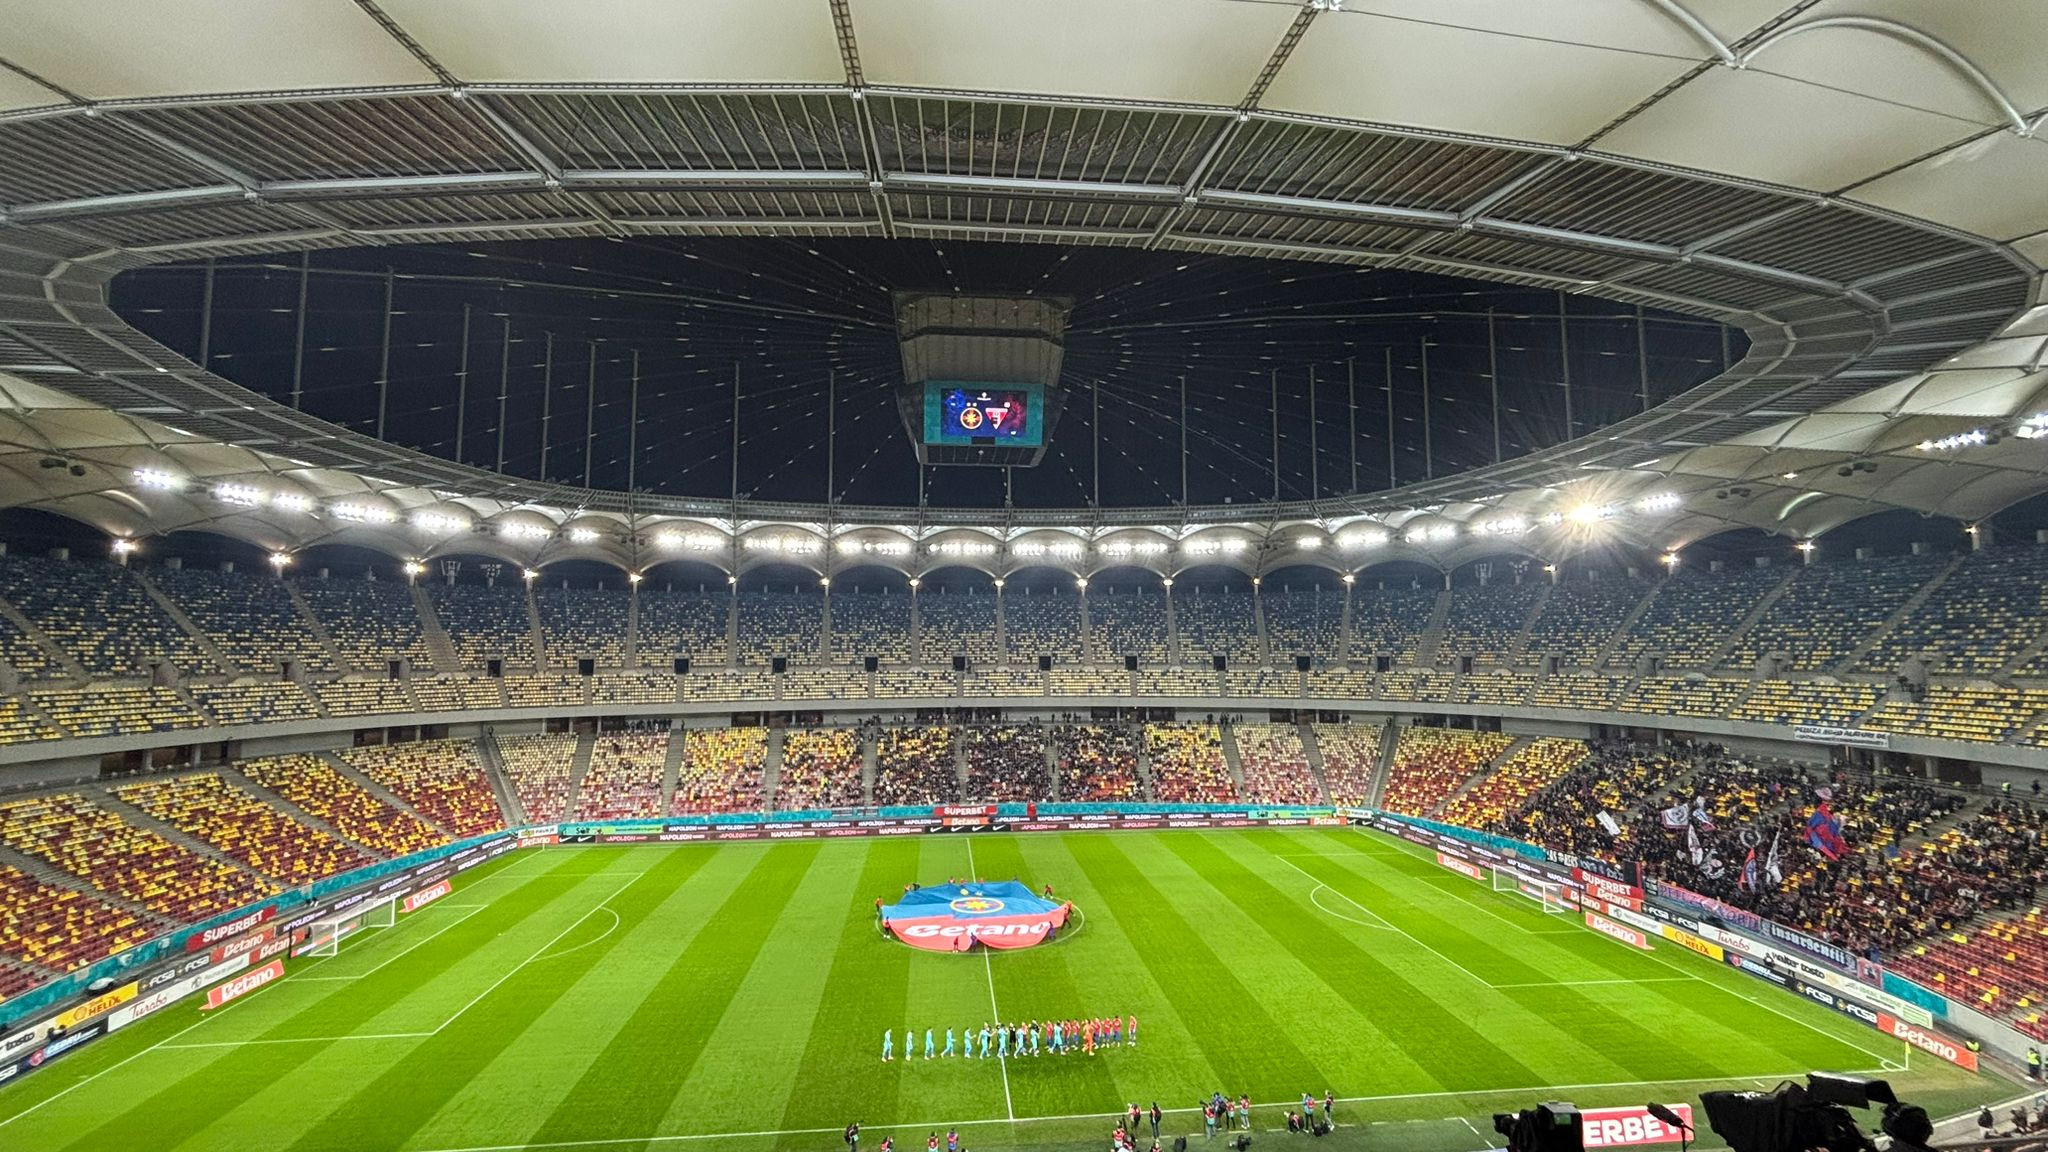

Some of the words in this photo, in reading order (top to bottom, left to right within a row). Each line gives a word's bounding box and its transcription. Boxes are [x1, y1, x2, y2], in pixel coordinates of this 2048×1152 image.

[944, 806, 987, 815] SUPERBET
[1582, 870, 1631, 896] SUPERBET
[1597, 887, 1631, 908] Betano
[202, 910, 264, 943] SUPERBET
[903, 920, 1051, 938] Betano
[1594, 914, 1637, 945] Betano
[223, 934, 264, 958] Betano
[1684, 939, 1709, 955] HELIX
[222, 967, 275, 1001] Betano
[88, 996, 121, 1016] HELIX
[1893, 1020, 1958, 1061] Betano
